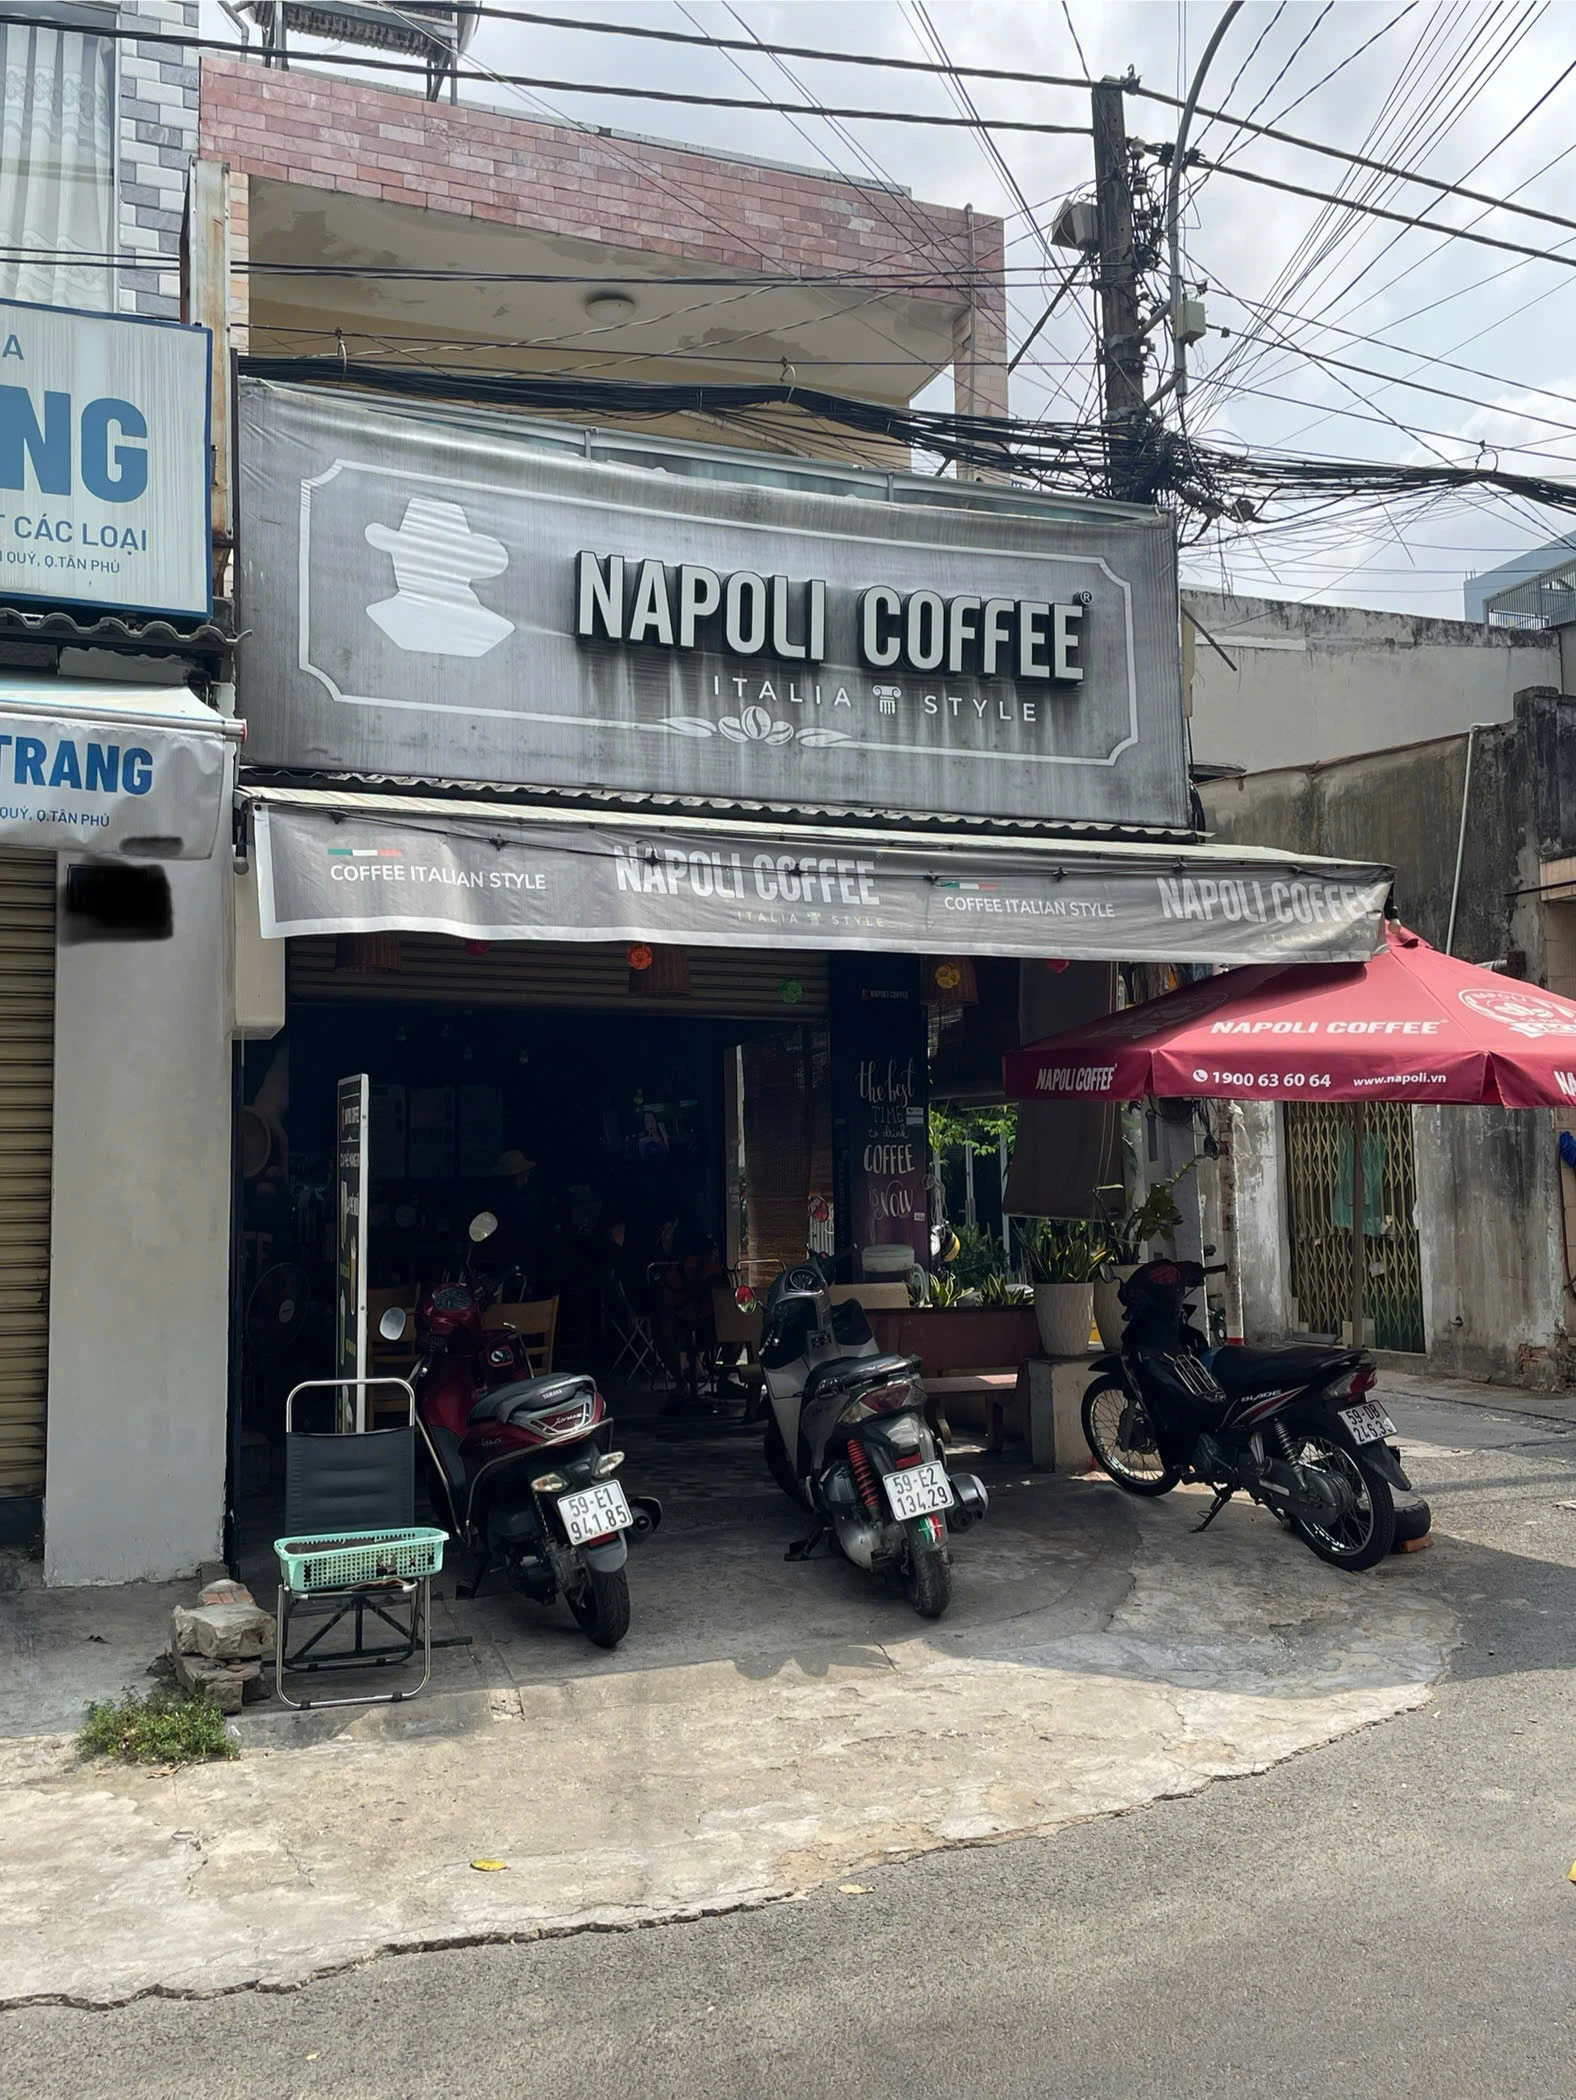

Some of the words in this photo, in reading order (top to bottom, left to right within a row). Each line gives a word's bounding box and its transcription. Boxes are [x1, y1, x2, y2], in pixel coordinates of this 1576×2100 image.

[2, 334, 24, 361] A
[0, 384, 148, 503] NG
[14, 513, 73, 543] CÁC
[82, 523, 147, 556] LOẠI
[91, 559, 120, 573] PHÚ
[576, 550, 827, 663] NAPOLI
[861, 585, 1084, 682] COFFEE
[713, 676, 852, 707] ITALIA
[924, 695, 1037, 722] STYLE
[81, 813, 110, 827] PHÚ
[330, 865, 406, 881] COFFEE
[410, 865, 484, 888] ITALIAN
[489, 871, 547, 890] STYLE
[613, 845, 745, 899] NAPOLI
[753, 854, 881, 905] COFFEE
[944, 896, 1003, 913] COFFEE
[1005, 899, 1066, 916] ITALIAN
[1069, 902, 1117, 918] STYLE
[1156, 877, 1267, 923] NAPOLI
[737, 910, 799, 924] ITALIA
[831, 915, 886, 928] STYLE
[1209, 1021, 1320, 1034] NAPOLI
[1326, 1021, 1440, 1034] COFFEE
[855, 1059, 886, 1103] the
[1035, 1067, 1076, 1092] NAPOLI
[1076, 1066, 1114, 1091] COFFEE
[1212, 1070, 1254, 1087] 1900
[1257, 1072, 1280, 1088] 63
[1283, 1072, 1305, 1087] 60
[1308, 1073, 1332, 1088] 64
[1353, 1072, 1447, 1088] www.napoli.vn
[863, 1143, 916, 1175] COFFEE
[893, 1467, 938, 1495] 59-E2
[568, 1487, 614, 1518] 59-E1
[897, 1486, 949, 1515] 134.29
[570, 1504, 628, 1540] 941.85
